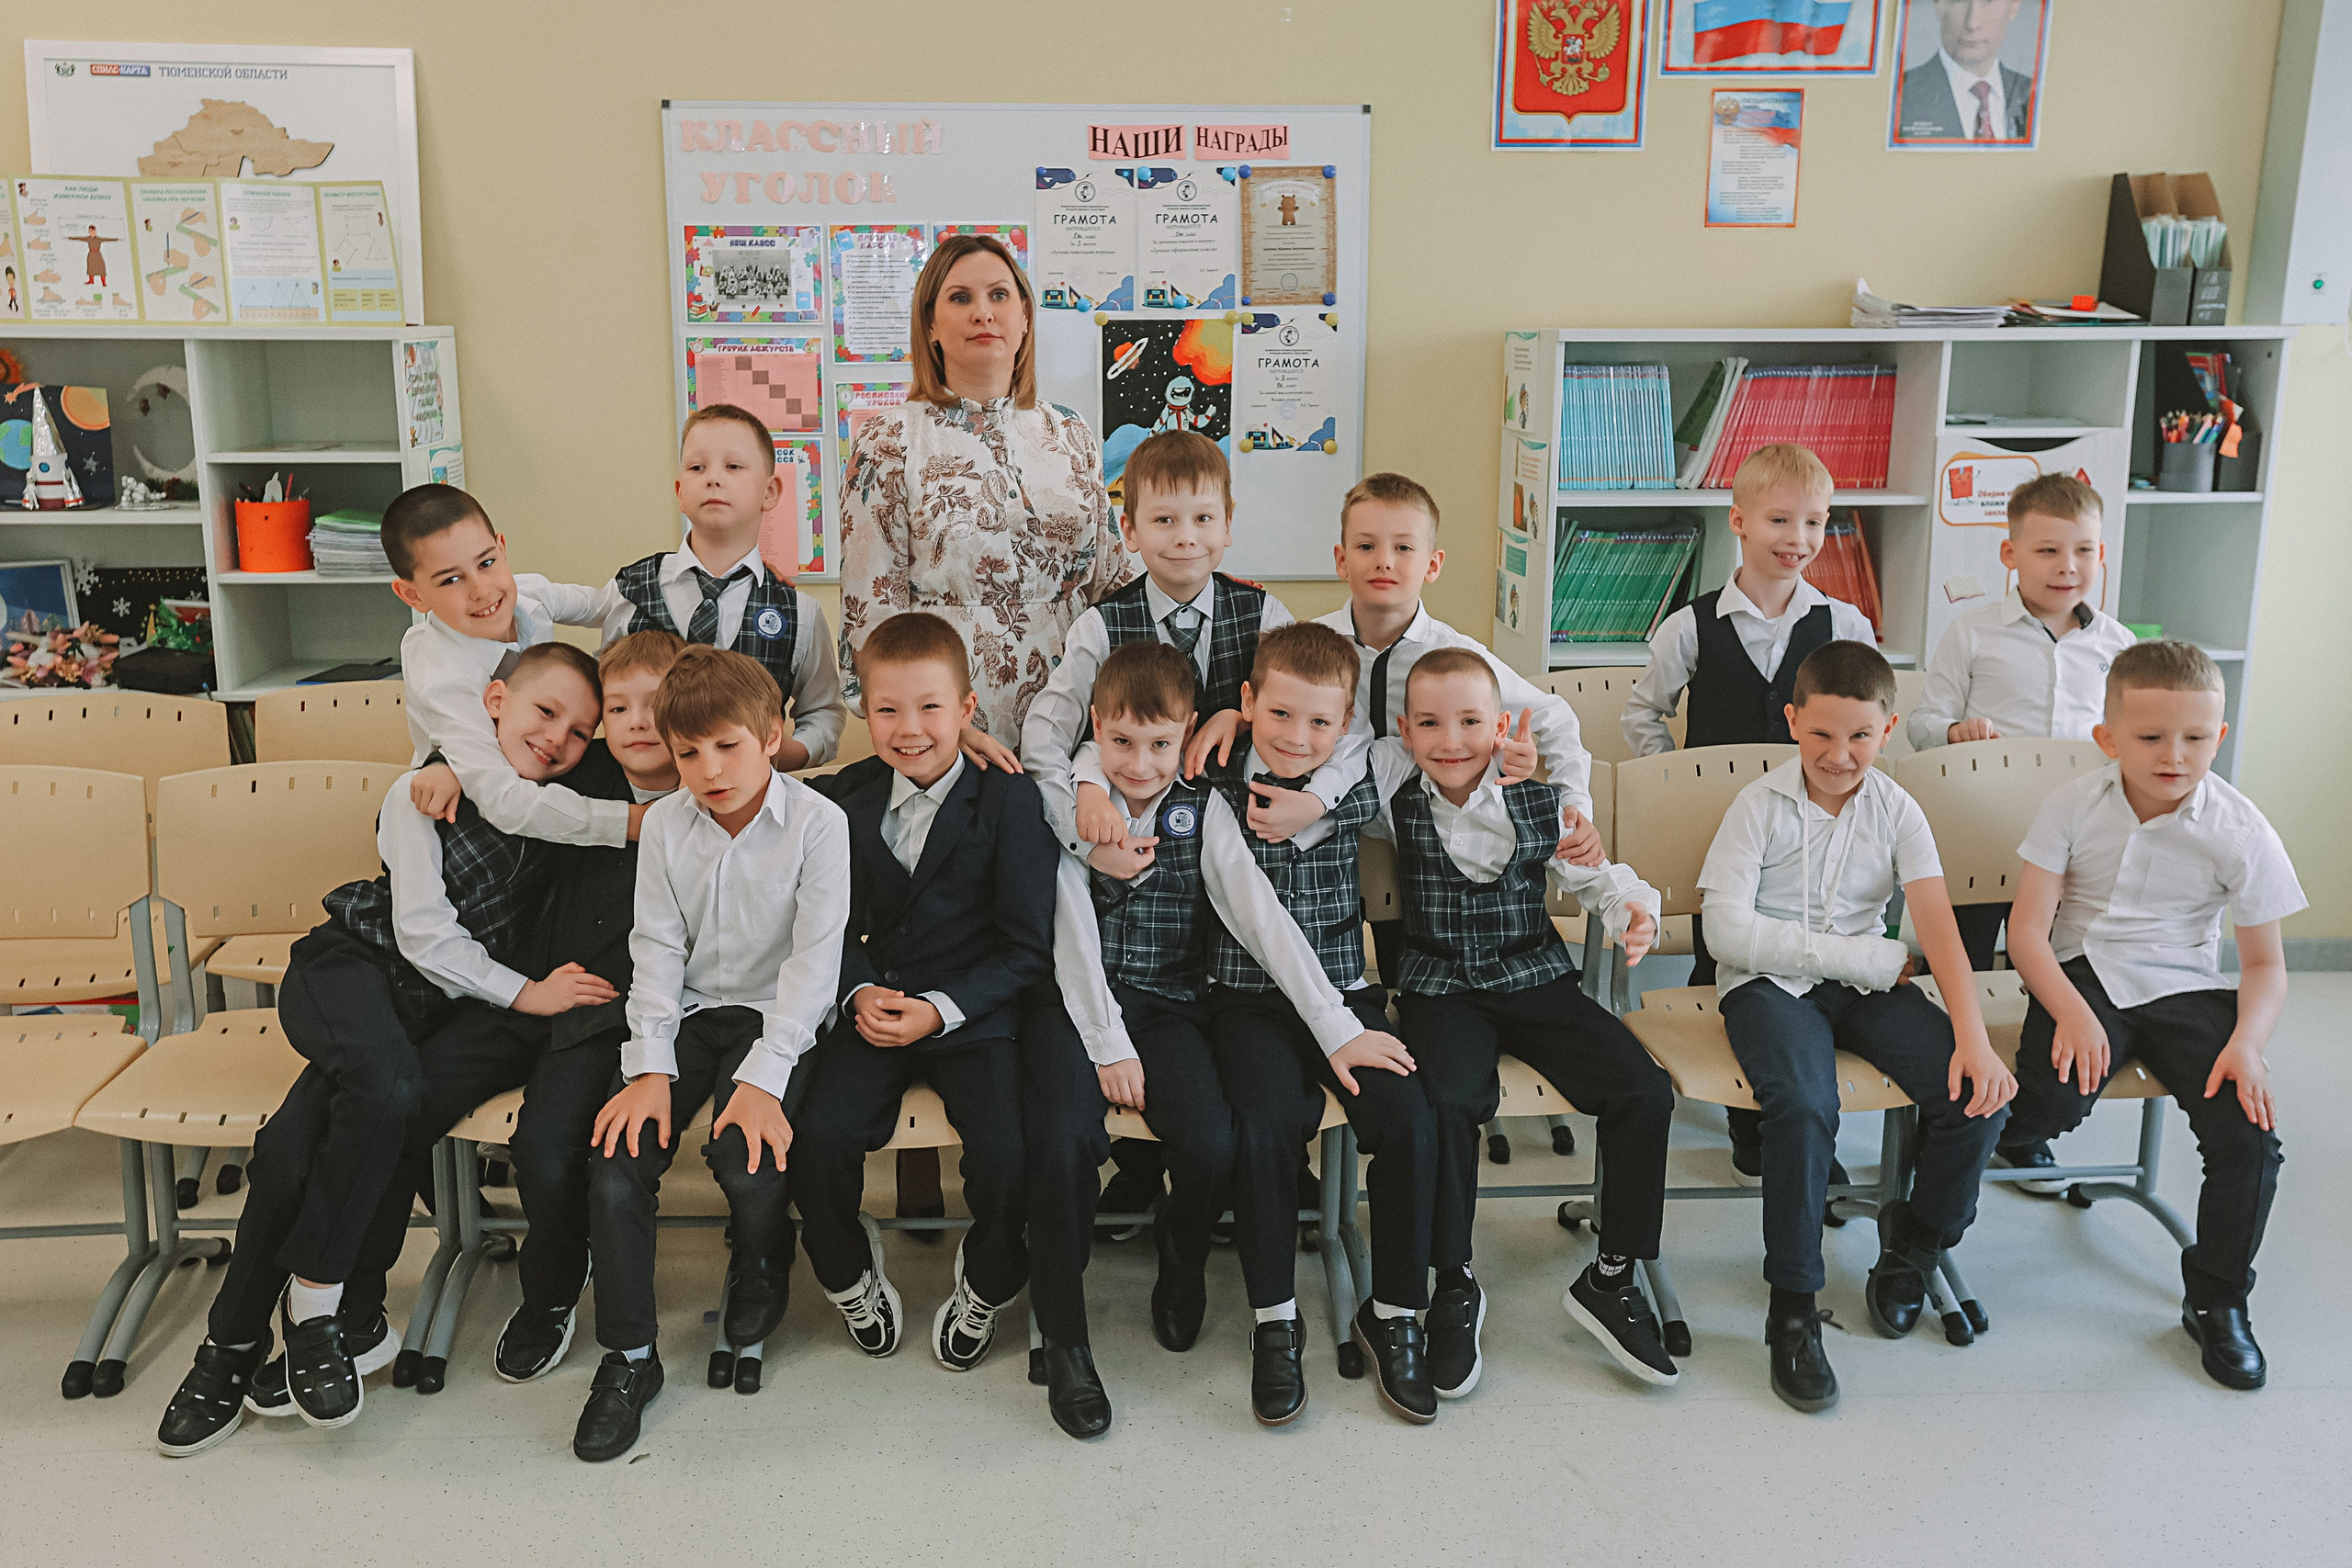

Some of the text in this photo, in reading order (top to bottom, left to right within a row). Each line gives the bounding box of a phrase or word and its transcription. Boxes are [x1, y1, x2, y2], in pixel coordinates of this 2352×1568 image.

[159, 65, 232, 79] ТЮМЕНСКОЙ
[234, 68, 288, 80] ОБЛАСТИ
[680, 117, 943, 154] КЛАССНЫЙ
[1089, 125, 1288, 159] НАШИ НАГРАДЫ
[701, 171, 898, 204] УГОЛОК
[1054, 214, 1117, 225] ГРАМОТА
[1155, 213, 1218, 224] ГРАМОТА
[1258, 358, 1319, 368] ГРАМОТА
